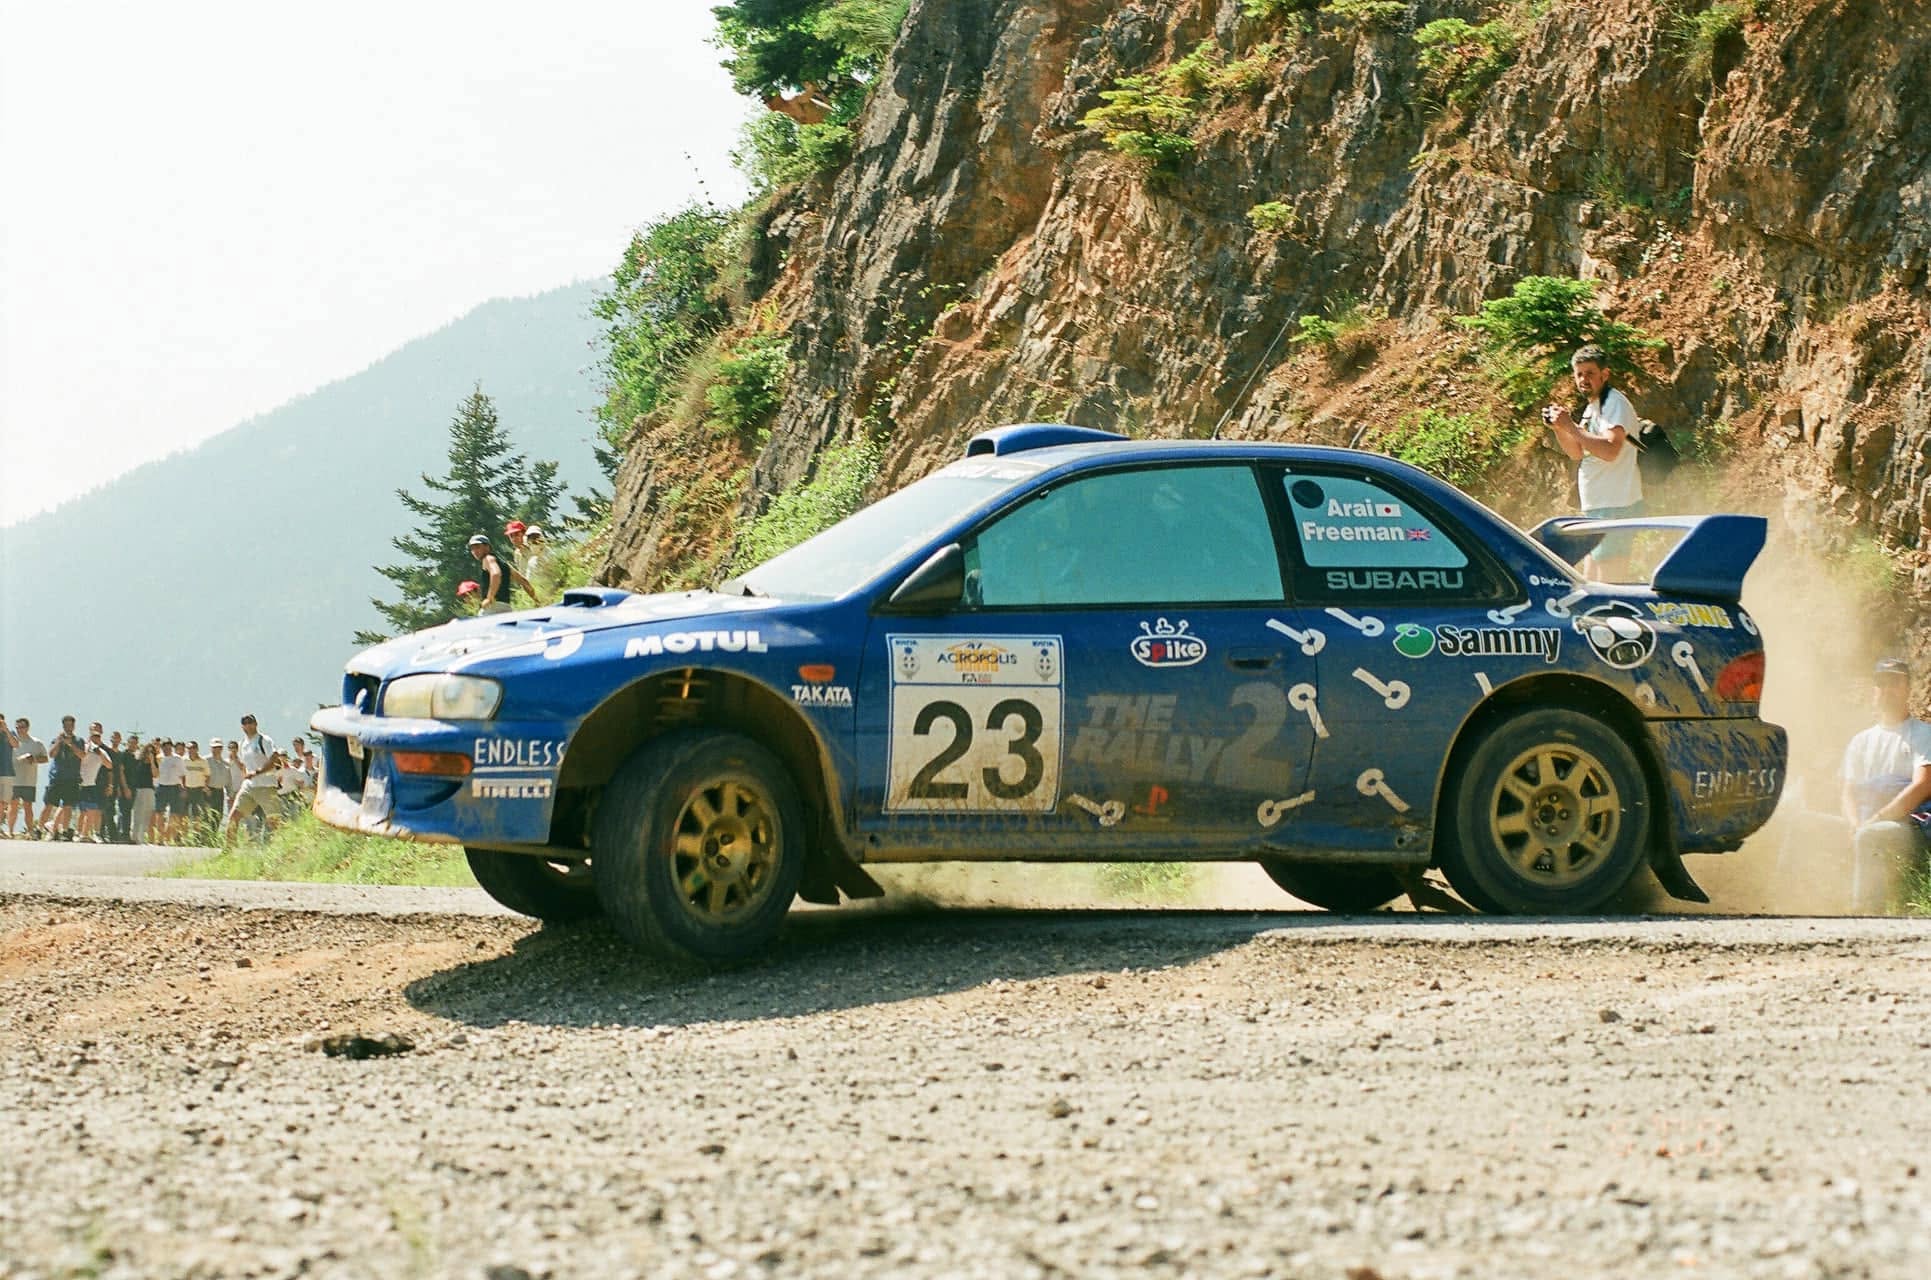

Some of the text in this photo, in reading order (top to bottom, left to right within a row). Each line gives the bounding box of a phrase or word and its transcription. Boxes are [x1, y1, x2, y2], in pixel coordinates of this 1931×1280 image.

[1327, 499, 1375, 517] Arai
[1303, 522, 1405, 541] Freeman
[1326, 571, 1463, 590] SUBARU
[623, 630, 768, 658] MOTUL
[1139, 640, 1201, 663] Spike
[1436, 624, 1561, 664] Sammy
[937, 653, 1017, 665] ACROPOLIS
[791, 685, 853, 705] TAKATA
[1085, 694, 1177, 731] THE
[474, 738, 567, 766] ENDLESS
[907, 698, 1045, 799] 23
[1214, 682, 1291, 795] 2
[1070, 726, 1226, 781] RALLY
